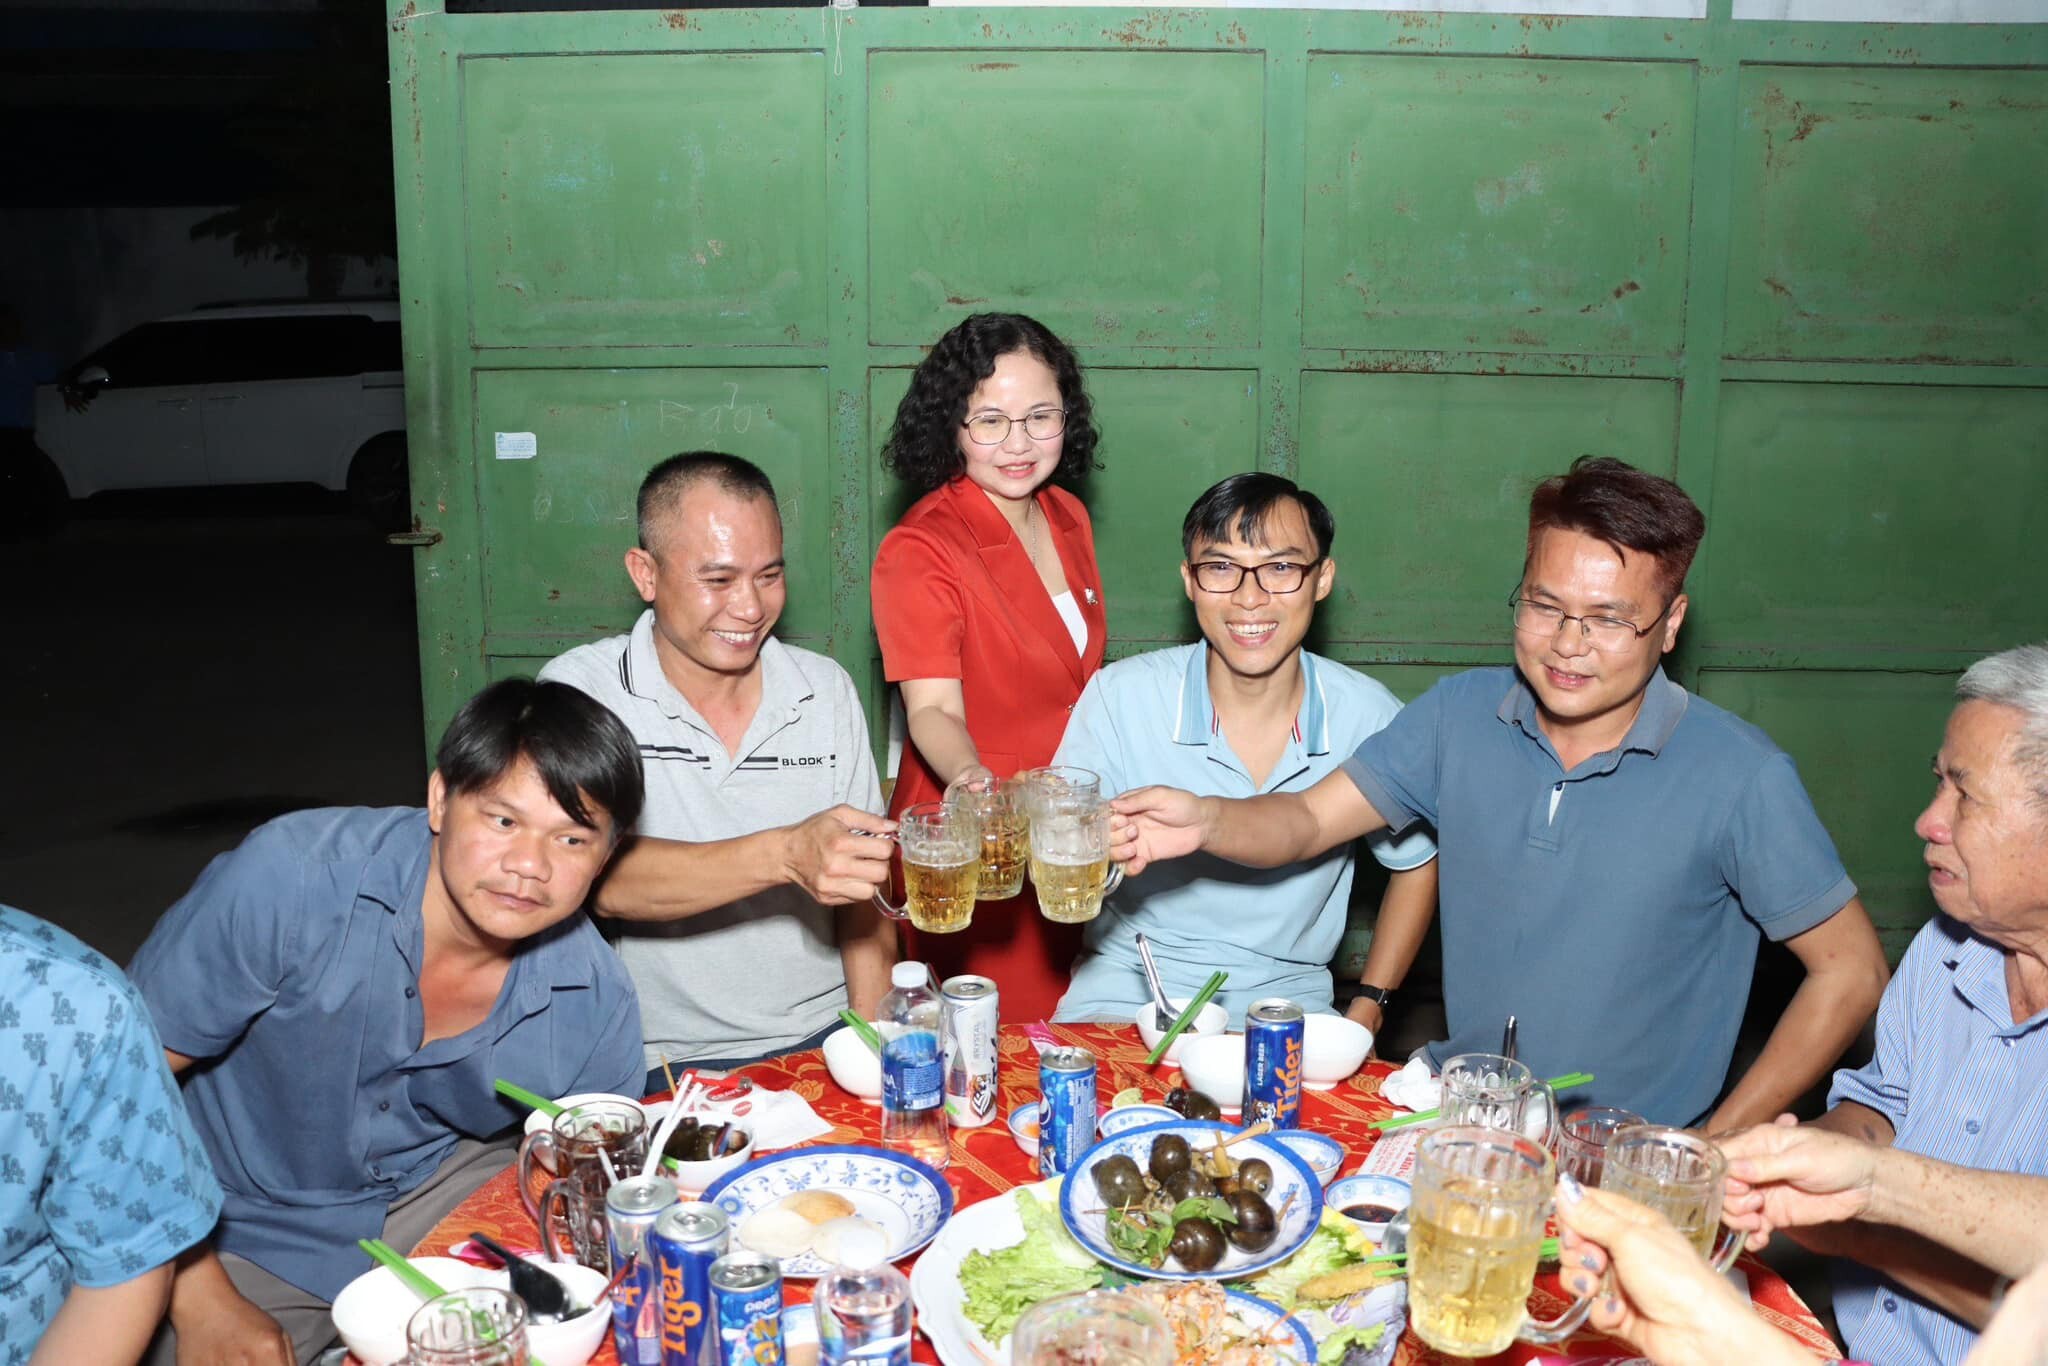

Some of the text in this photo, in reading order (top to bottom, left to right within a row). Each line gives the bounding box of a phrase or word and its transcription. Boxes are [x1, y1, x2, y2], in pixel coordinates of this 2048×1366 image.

[782, 757, 824, 766] BLOOK
[1274, 1037, 1301, 1119] Tiger
[660, 1255, 703, 1355] Tiger
